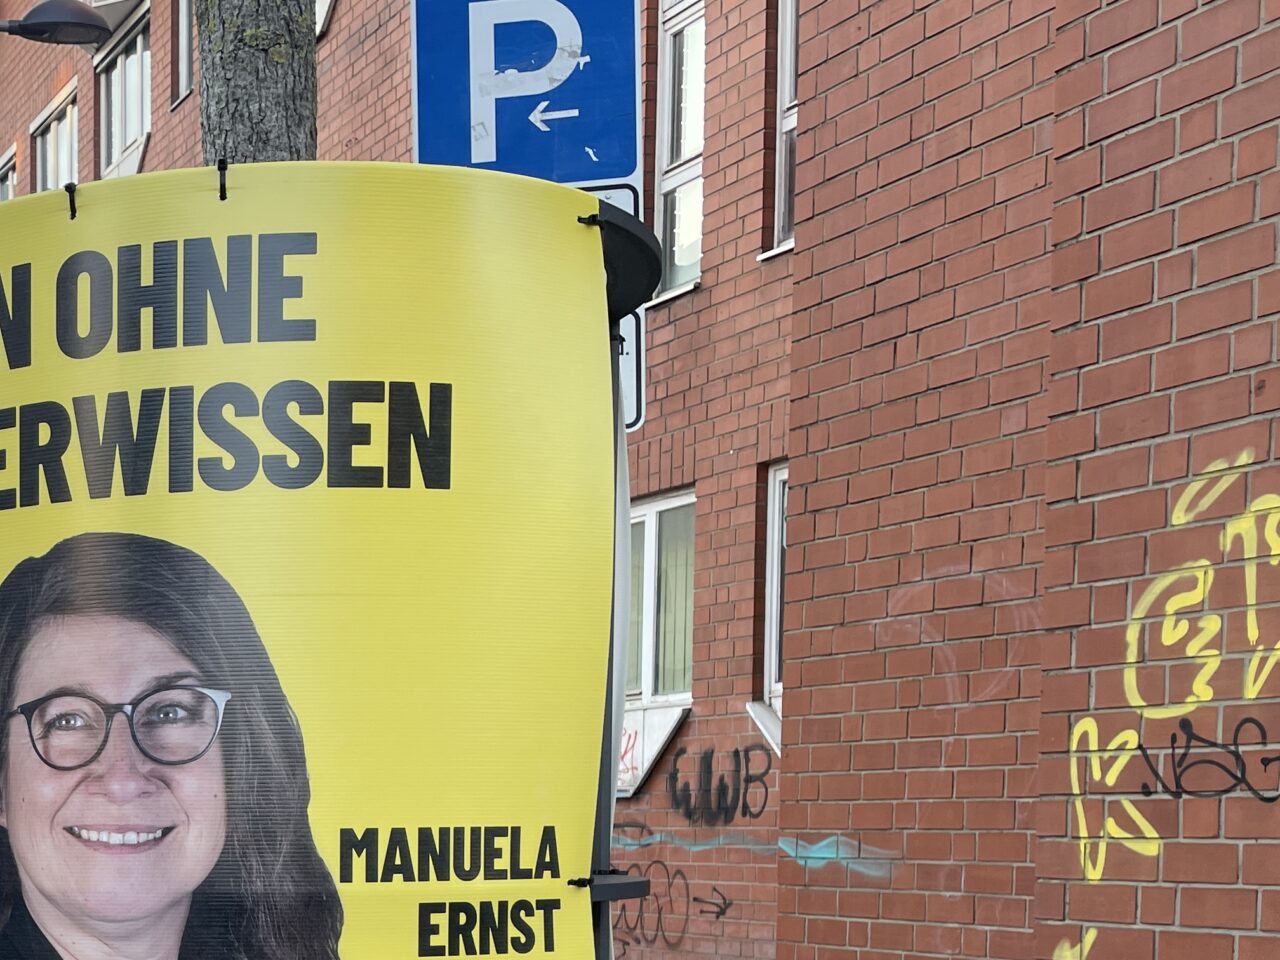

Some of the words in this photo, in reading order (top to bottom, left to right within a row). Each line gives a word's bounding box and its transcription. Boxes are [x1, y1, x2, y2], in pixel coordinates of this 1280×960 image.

[469, 0, 583, 163] P
[55, 232, 318, 361] OHNE
[339, 825, 561, 883] MANUELA
[417, 898, 561, 957] ERNST
